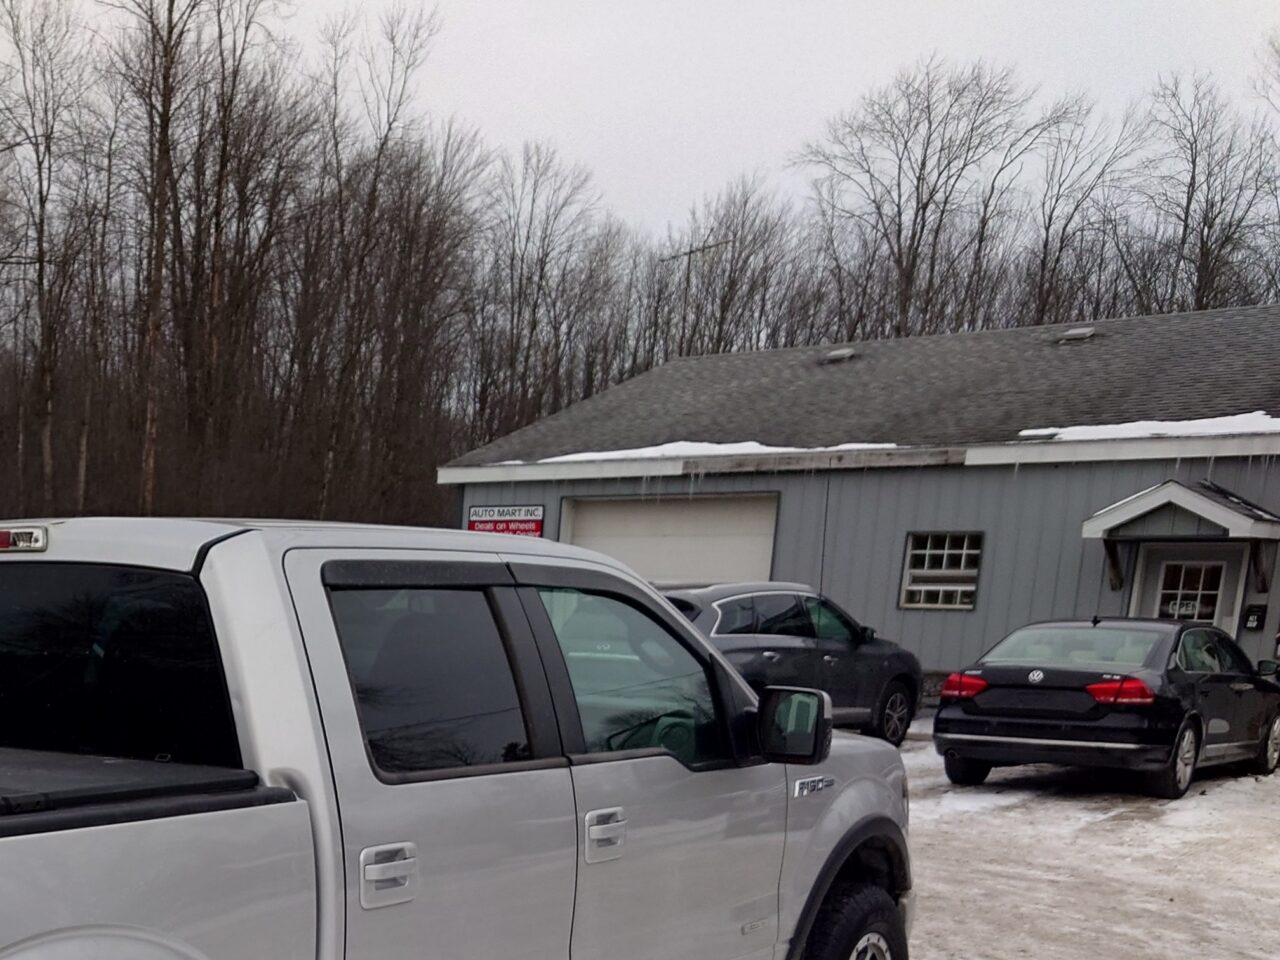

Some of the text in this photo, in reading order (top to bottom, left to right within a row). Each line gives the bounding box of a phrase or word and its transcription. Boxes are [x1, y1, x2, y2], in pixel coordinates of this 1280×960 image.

[471, 509, 494, 518] AUTO
[497, 508, 522, 517] MART
[475, 522, 535, 530] Deals on Wheels
